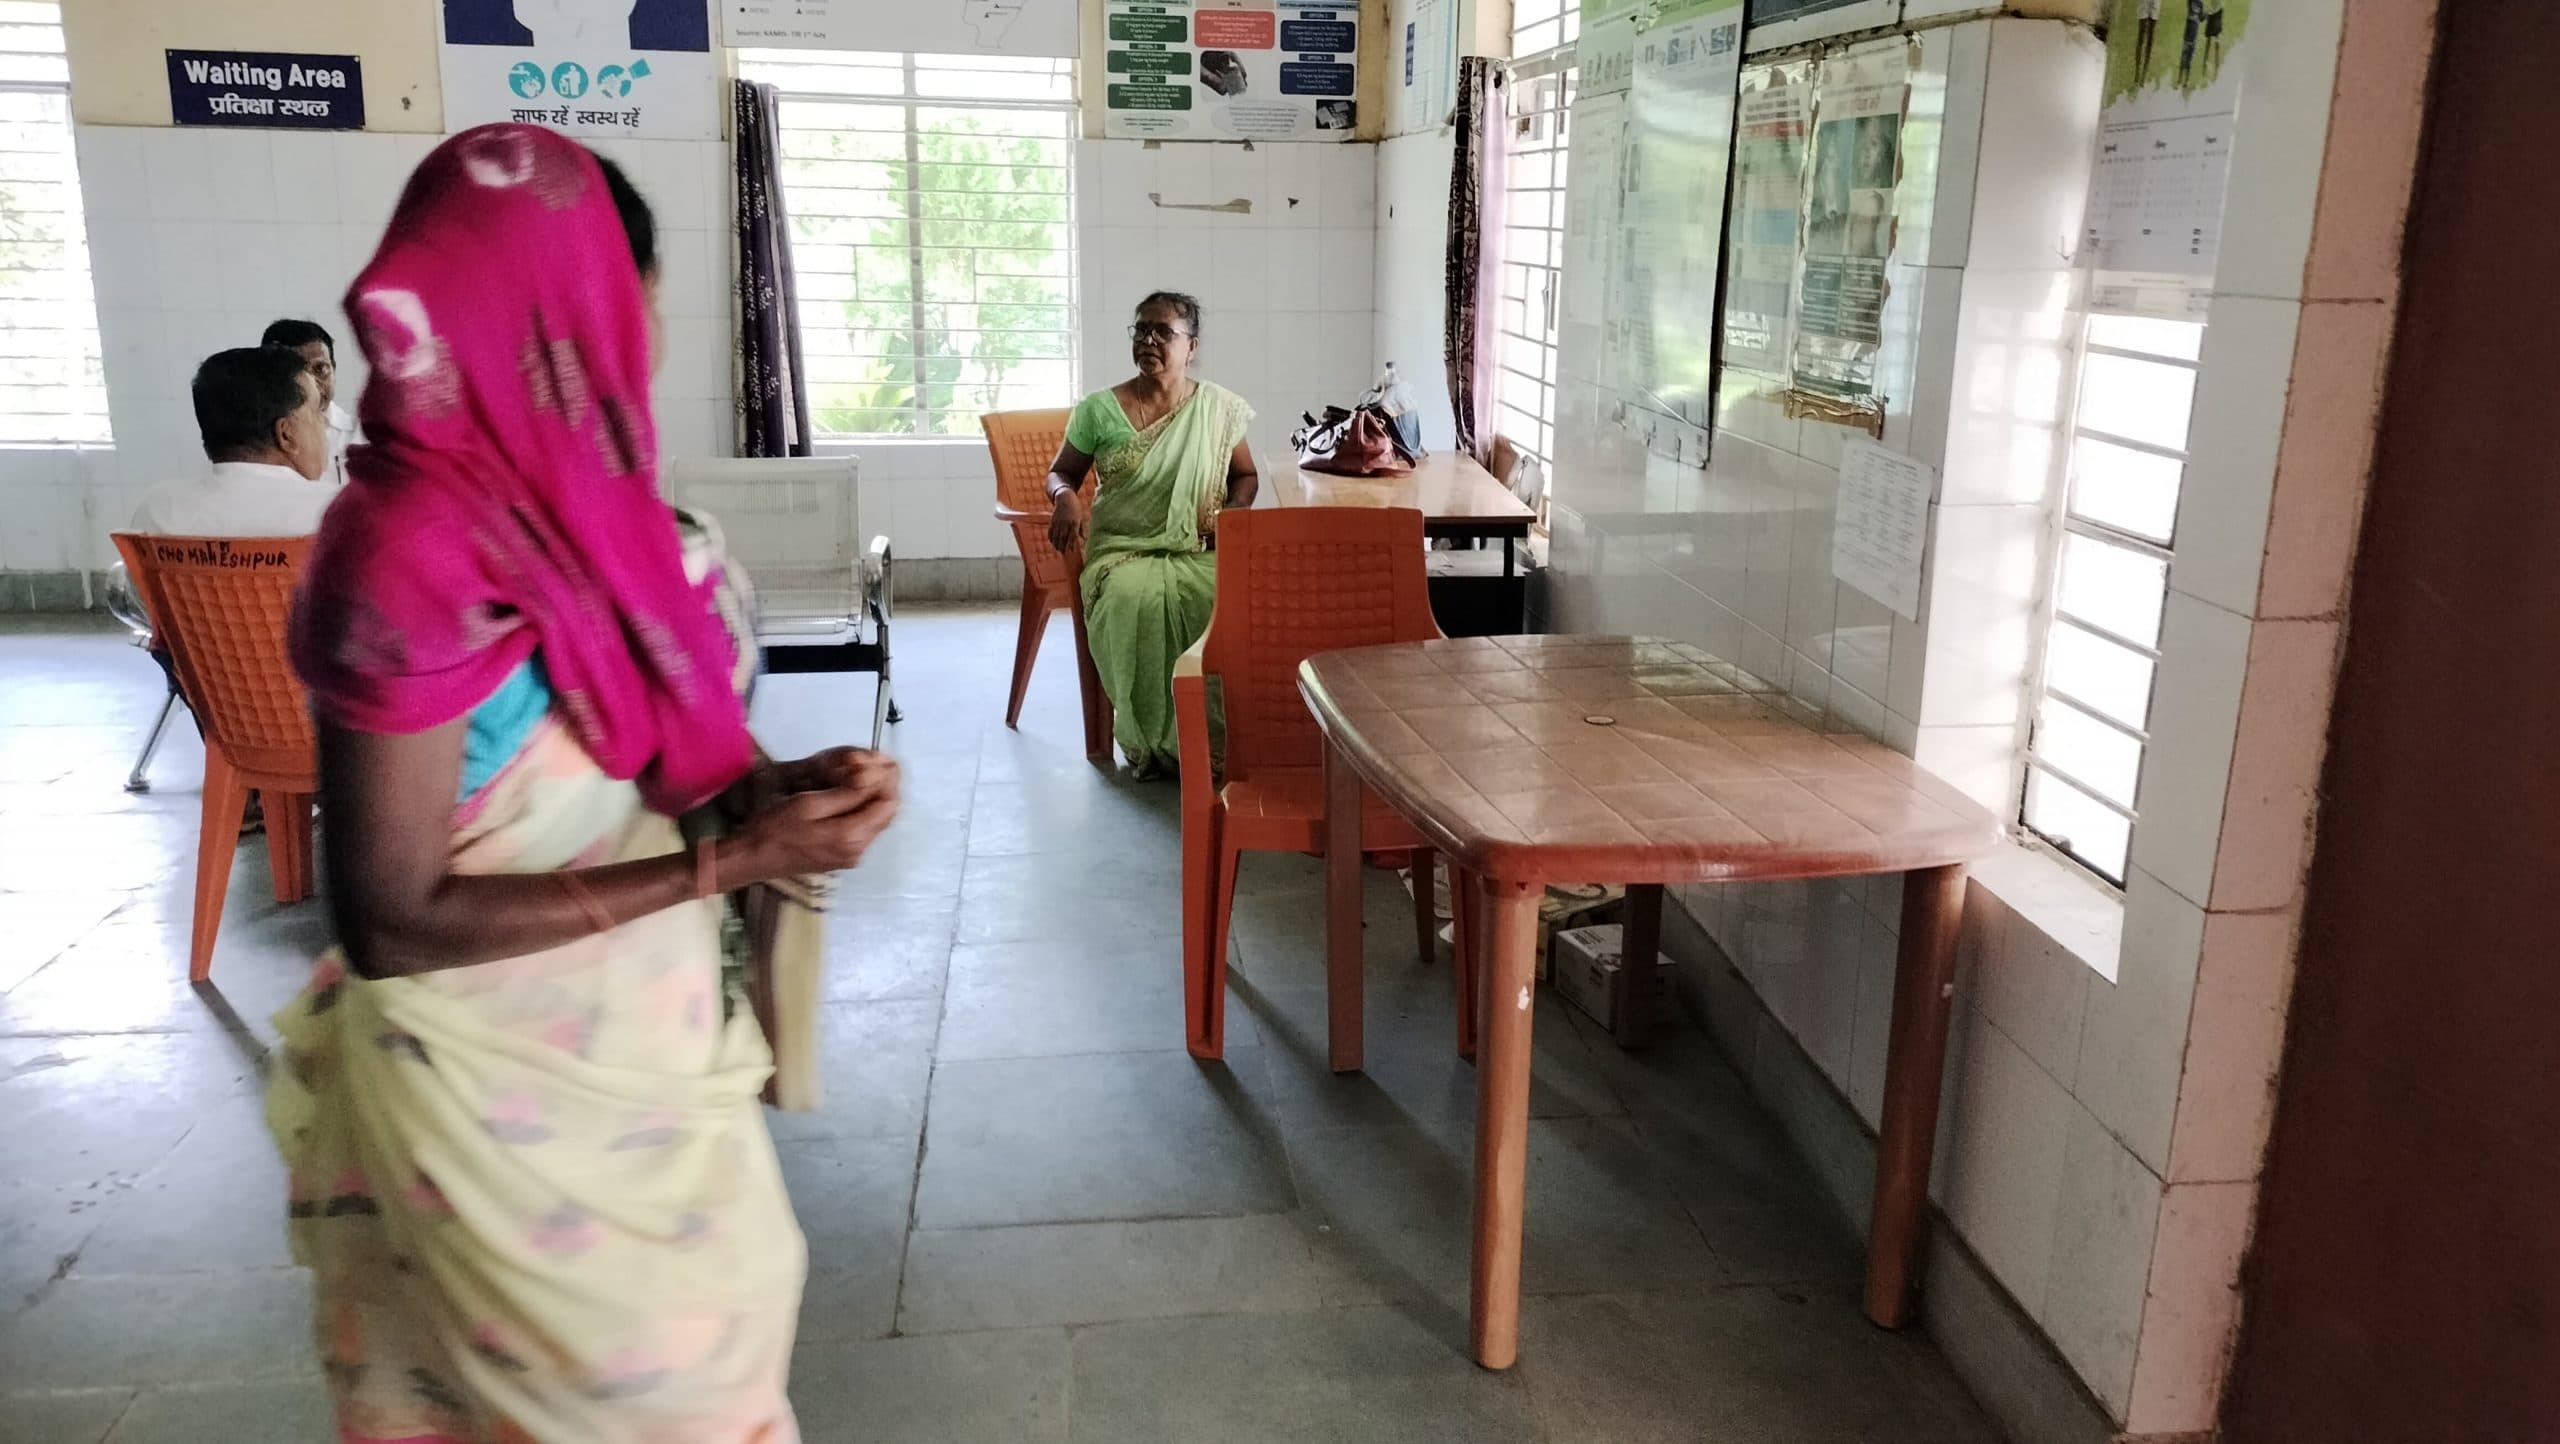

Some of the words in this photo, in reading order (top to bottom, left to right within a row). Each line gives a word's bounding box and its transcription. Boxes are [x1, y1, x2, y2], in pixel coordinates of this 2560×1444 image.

[184, 60, 283, 91] Waiting
[288, 63, 346, 88] Area
[208, 93, 275, 115] प्रतिक्षा
[278, 98, 331, 117] स्थल
[510, 109, 548, 124] साफ
[550, 105, 570, 126] रहें
[576, 110, 619, 125] स्वस्थ
[620, 107, 641, 128] रहें
[187, 545, 290, 570] MAHESHPUR
